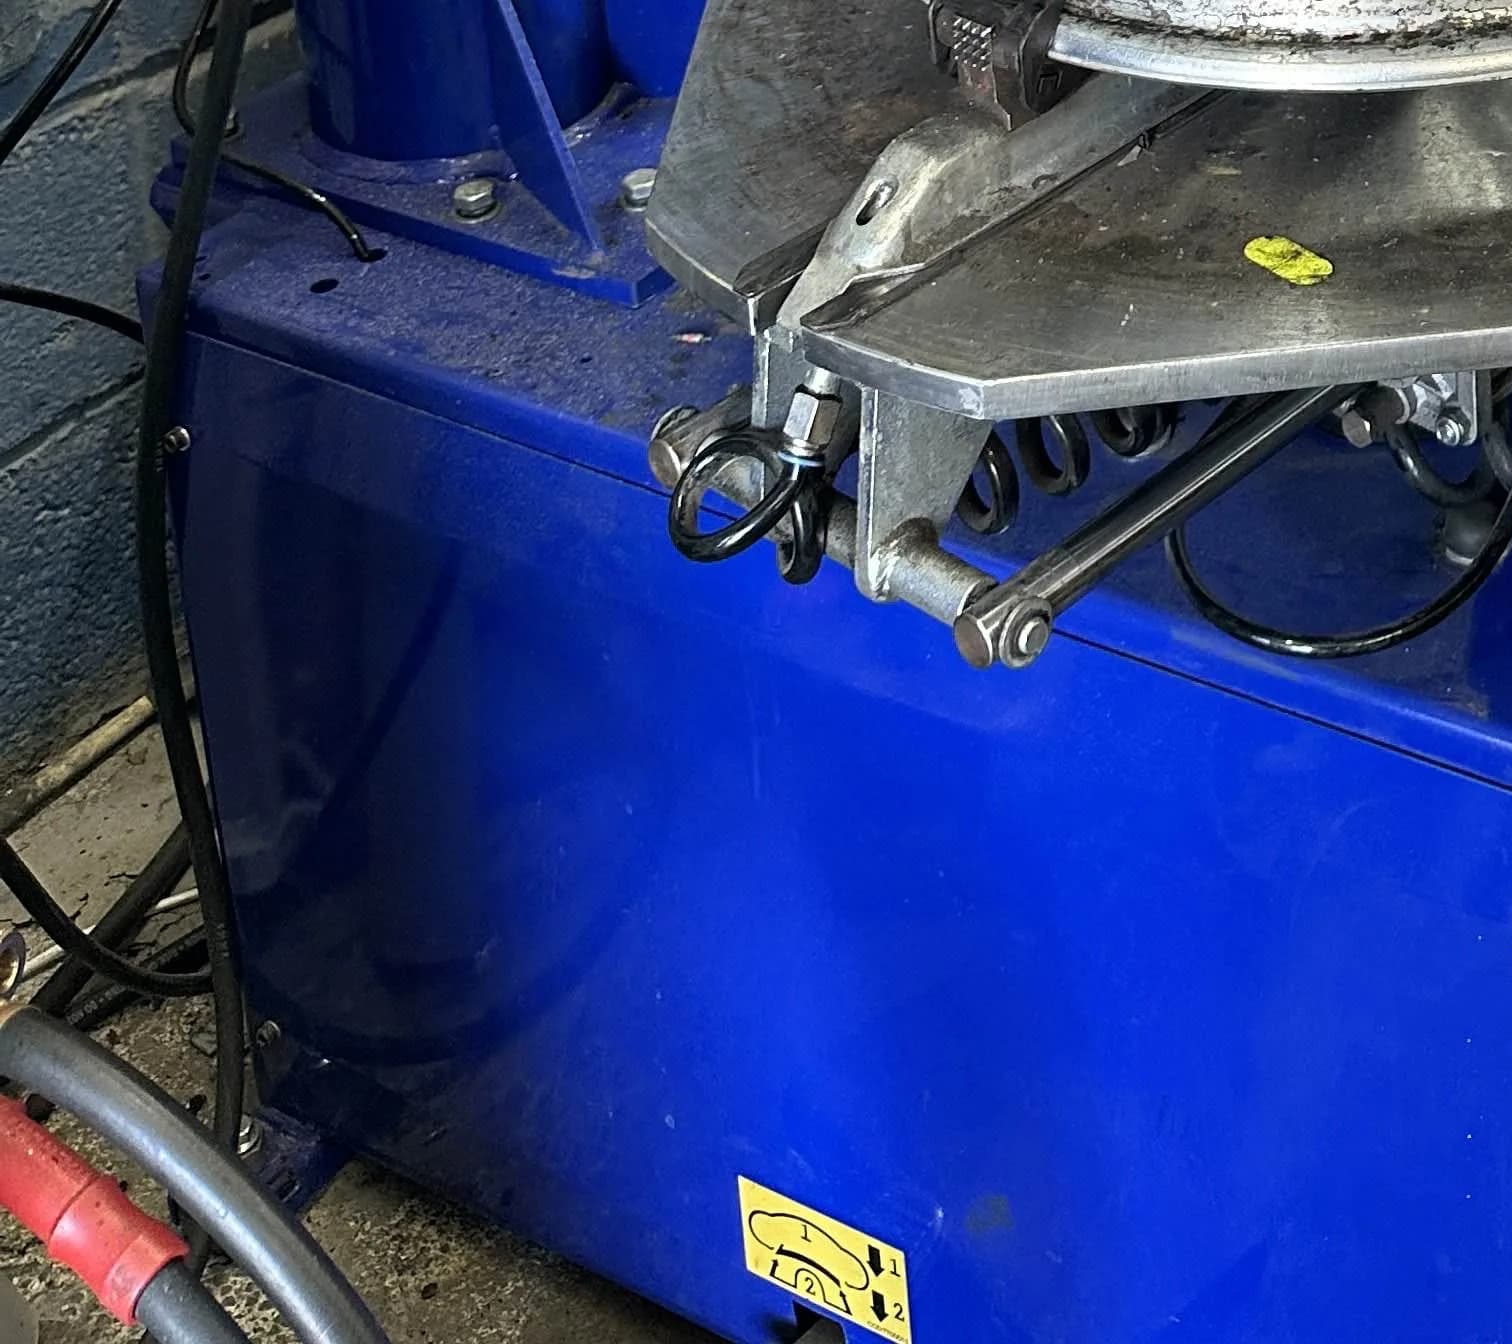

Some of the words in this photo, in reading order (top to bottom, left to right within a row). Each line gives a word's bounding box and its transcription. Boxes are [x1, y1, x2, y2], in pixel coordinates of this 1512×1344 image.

[800, 1224, 812, 1243] 1
[889, 1258, 901, 1278] 1
[803, 1276, 816, 1296] 2
[892, 1302, 905, 1322] 2
